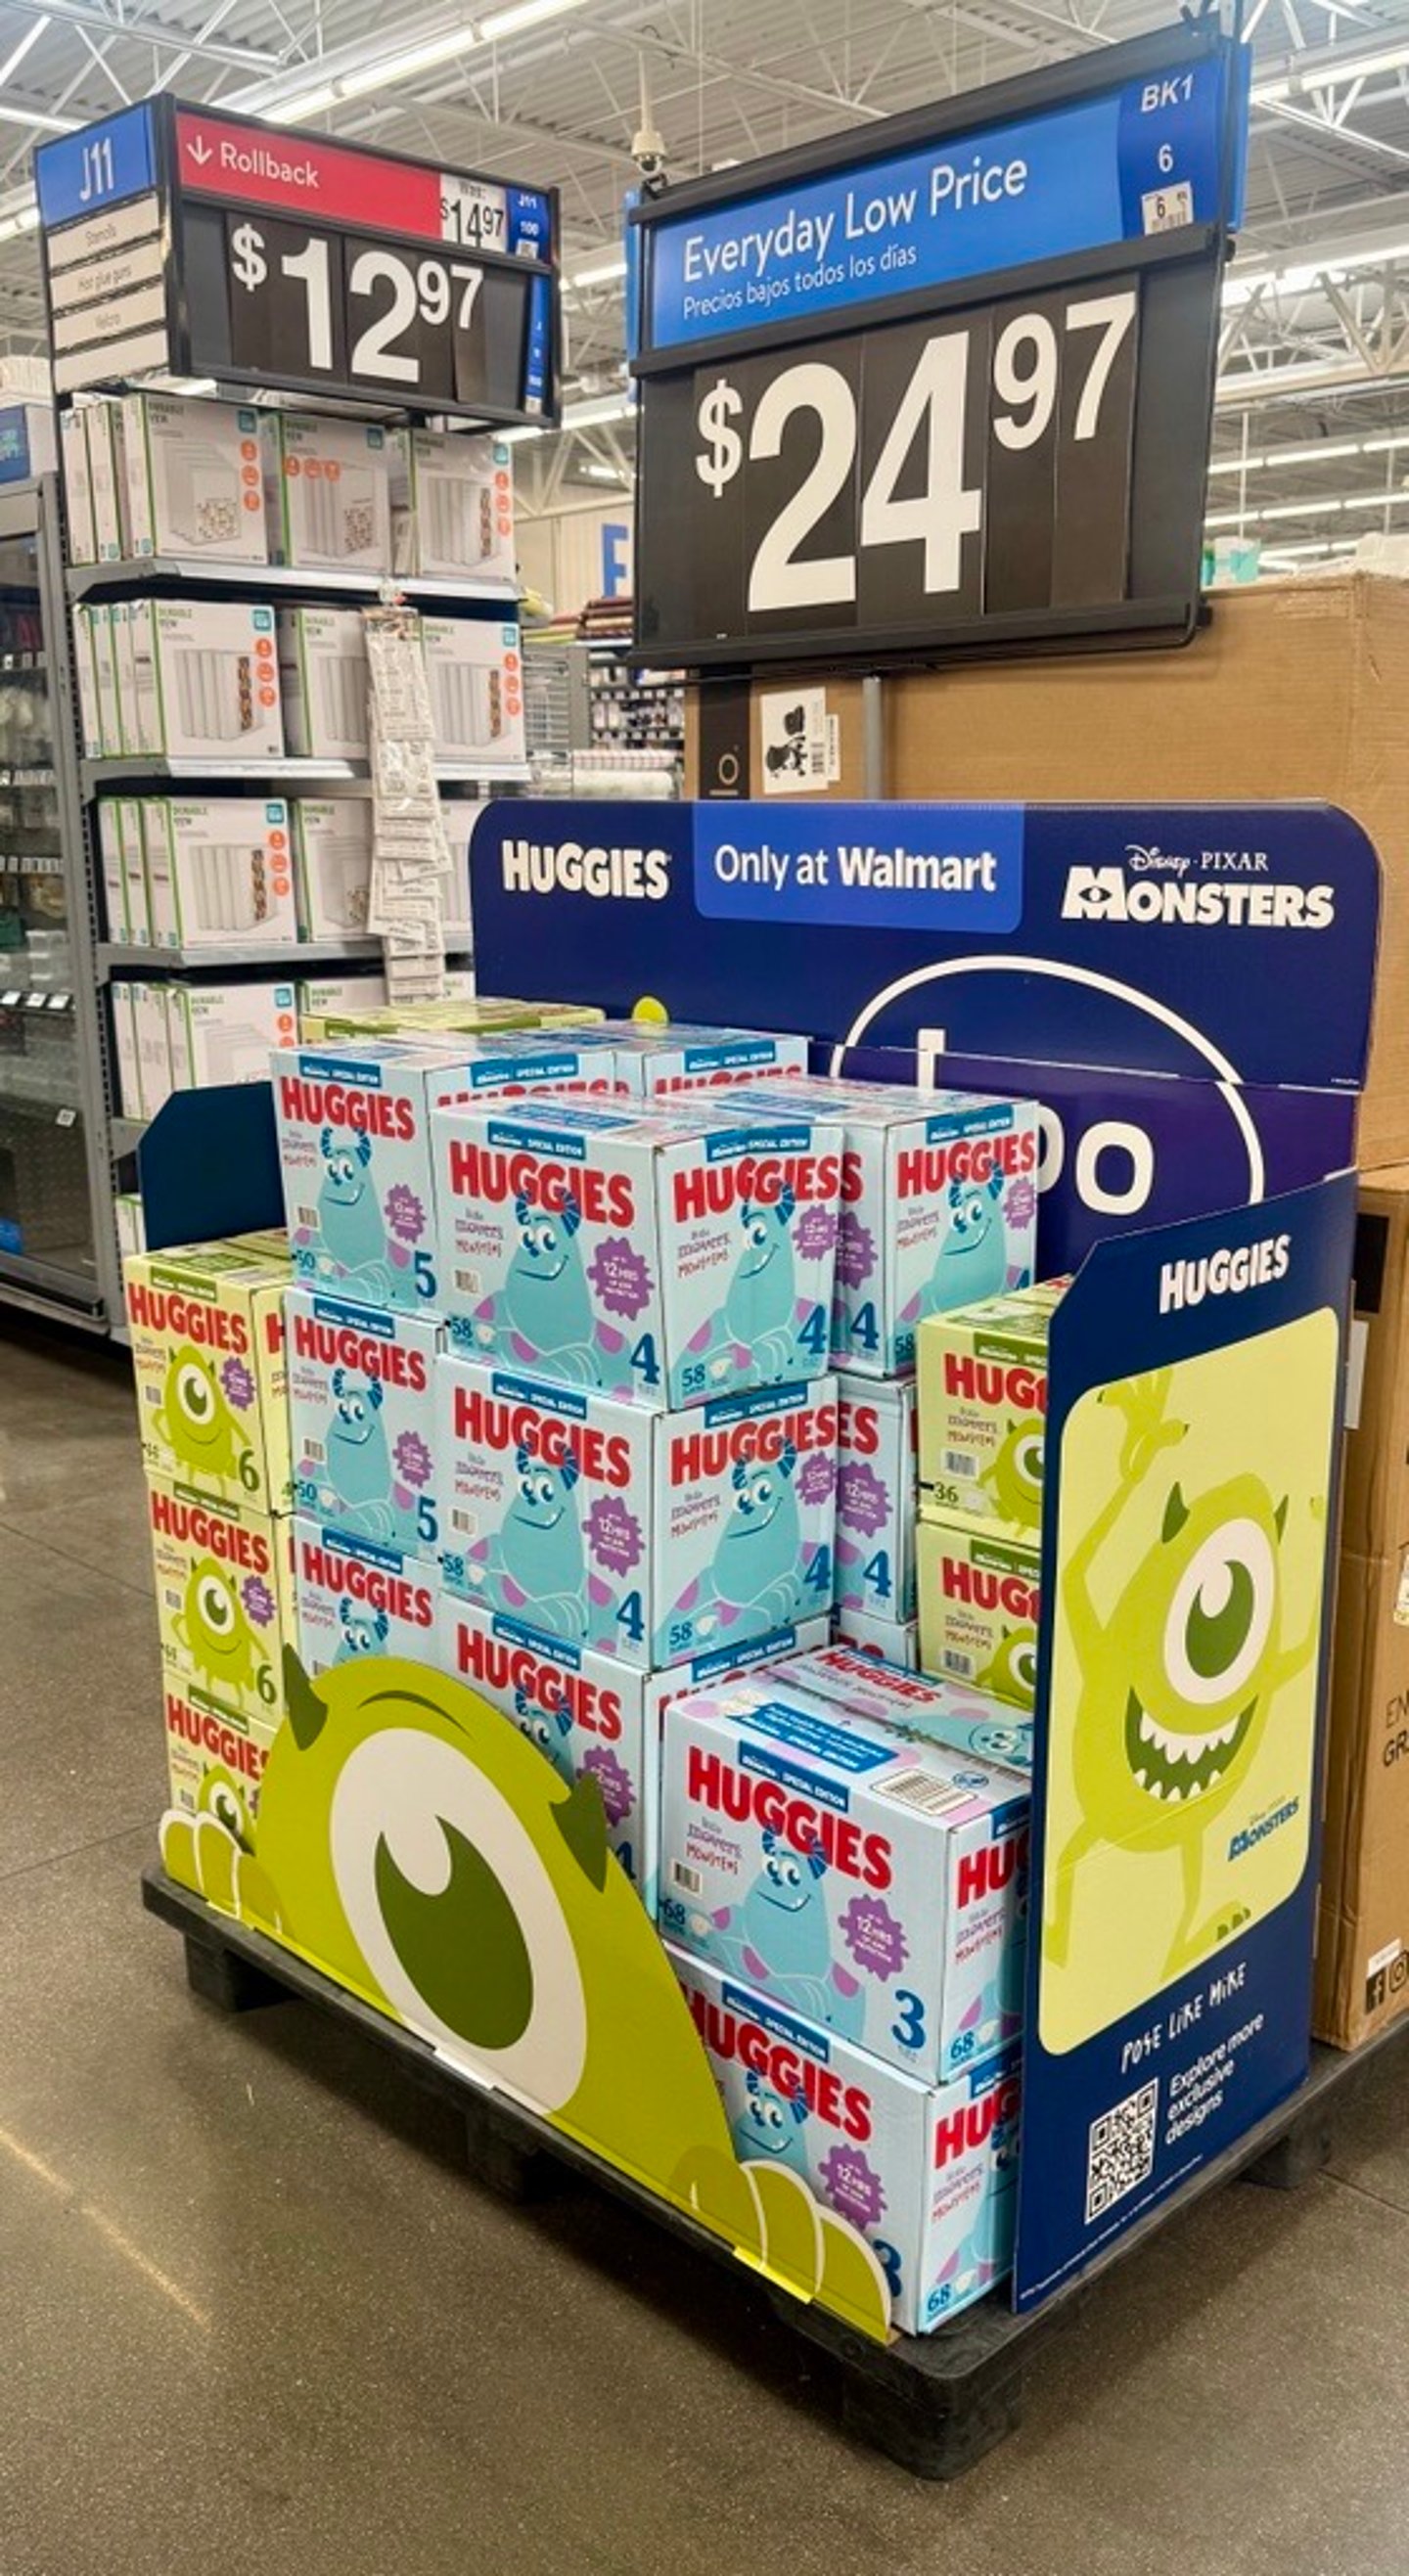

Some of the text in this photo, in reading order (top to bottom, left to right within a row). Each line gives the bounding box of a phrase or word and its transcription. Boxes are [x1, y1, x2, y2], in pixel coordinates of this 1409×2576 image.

[1141, 72, 1194, 112] BK1
[79, 136, 114, 202] J11
[221, 142, 318, 188] Rollback
[1159, 144, 1173, 172] 6
[685, 156, 1028, 283] Everyday Low Price
[685, 242, 918, 320] Precios bajos todos los días
[502, 839, 670, 900] HUGGIES
[715, 844, 997, 892] Only at Walmart
[1125, 844, 1269, 878] Disney PIXAR
[1061, 865, 1335, 928] MONSTERS
[282, 1079, 415, 1141] HUGGIES
[528, 1138, 553, 1152] SPECIAL
[897, 1132, 1035, 1198] HUGGIES
[450, 1142, 635, 1228] HUGGIES
[673, 1155, 841, 1223] HUGGIES
[297, 1253, 315, 1271] 50
[415, 1251, 436, 1298] 5
[1159, 1235, 1290, 1314] HUGGIES
[127, 1284, 250, 1355] HUGGIES
[451, 1318, 474, 1339] 58
[798, 1304, 827, 1355] 4
[850, 1303, 879, 1351] 4
[295, 1317, 426, 1391] HUGGIES
[631, 1333, 659, 1384] 4
[896, 1335, 914, 1357] 58
[683, 1363, 705, 1386] 58
[454, 1388, 631, 1488] HUGGIES
[670, 1406, 839, 1486] HUGGIES
[239, 1449, 259, 1492] 6
[296, 1483, 317, 1503] 50
[934, 1480, 959, 1503] 36
[151, 1492, 270, 1575] HUGGIES
[417, 1497, 438, 1544] 5
[303, 1543, 432, 1628] HUGGIES
[443, 1554, 465, 1577] 58
[805, 1546, 831, 1593] 4
[863, 1550, 891, 1598] 4
[616, 1591, 645, 1642] 4
[670, 1622, 692, 1646] 58
[256, 1663, 278, 1705] 6
[458, 1624, 622, 1741] HUGGIES
[816, 1650, 941, 1702] HUGGIES
[784, 1773, 845, 1807] SPECIAL EDITION
[687, 1745, 892, 1891] HUGGIES
[663, 1901, 685, 1925] 68
[857, 1915, 872, 1933] 12
[765, 2017, 795, 2041] SPECIAL
[892, 1989, 926, 2050] 3
[951, 2031, 976, 2056] 68
[1121, 2023, 1162, 2073] POSE
[1170, 2013, 1264, 2097] Explore more
[1166, 2059, 1235, 2121] exclusive
[1165, 2090, 1223, 2145] designs
[929, 2283, 952, 2312] 68
